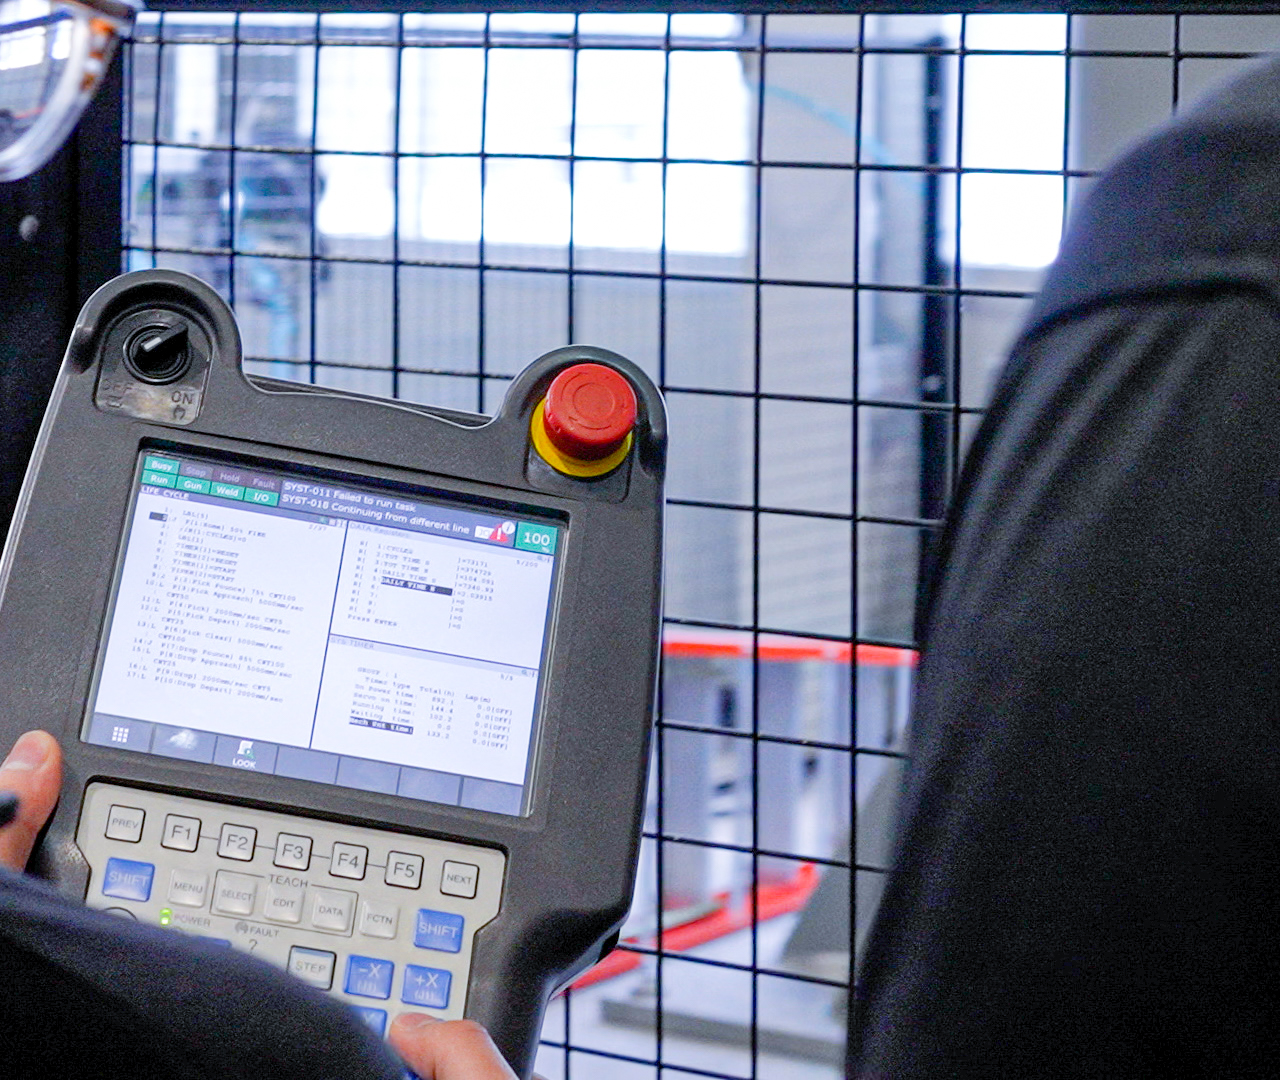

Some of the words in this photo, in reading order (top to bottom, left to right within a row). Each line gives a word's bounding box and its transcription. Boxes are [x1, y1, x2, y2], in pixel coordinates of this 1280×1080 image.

[171, 390, 194, 404] ON
[151, 460, 173, 471] Busy
[220, 472, 240, 483] Hold
[253, 478, 276, 489] Fault
[150, 474, 169, 484] Run
[183, 480, 203, 490] Gun
[216, 486, 239, 497] Weld
[253, 492, 270, 503] I/O
[284, 481, 332, 498] SYST-011
[333, 490, 362, 503] Failed
[364, 497, 374, 505] to
[376, 499, 393, 509] run
[395, 502, 417, 513] task
[331, 502, 383, 521] Continuing
[385, 512, 408, 524] from
[410, 516, 451, 531] different
[452, 524, 470, 534] line
[524, 532, 550, 546] 100
[232, 758, 256, 769] LOOK
[112, 818, 139, 829] PREV
[171, 825, 191, 840] F1
[226, 834, 248, 851] F2
[281, 843, 304, 860] F3
[337, 852, 359, 869] F4
[393, 862, 415, 878] F5
[109, 871, 150, 887] SHIFT
[269, 874, 308, 888] TEACH
[446, 873, 472, 885] NEXT
[173, 882, 203, 894] MENU
[221, 889, 252, 901] SELECT
[273, 898, 296, 909] EDIT
[318, 905, 343, 916] DATA
[174, 913, 211, 927] POWER
[367, 913, 393, 925] FCTN
[249, 926, 280, 937] FAULT
[419, 922, 458, 939] SHIFT
[295, 960, 326, 973] STEP
[415, 972, 439, 988] +X
